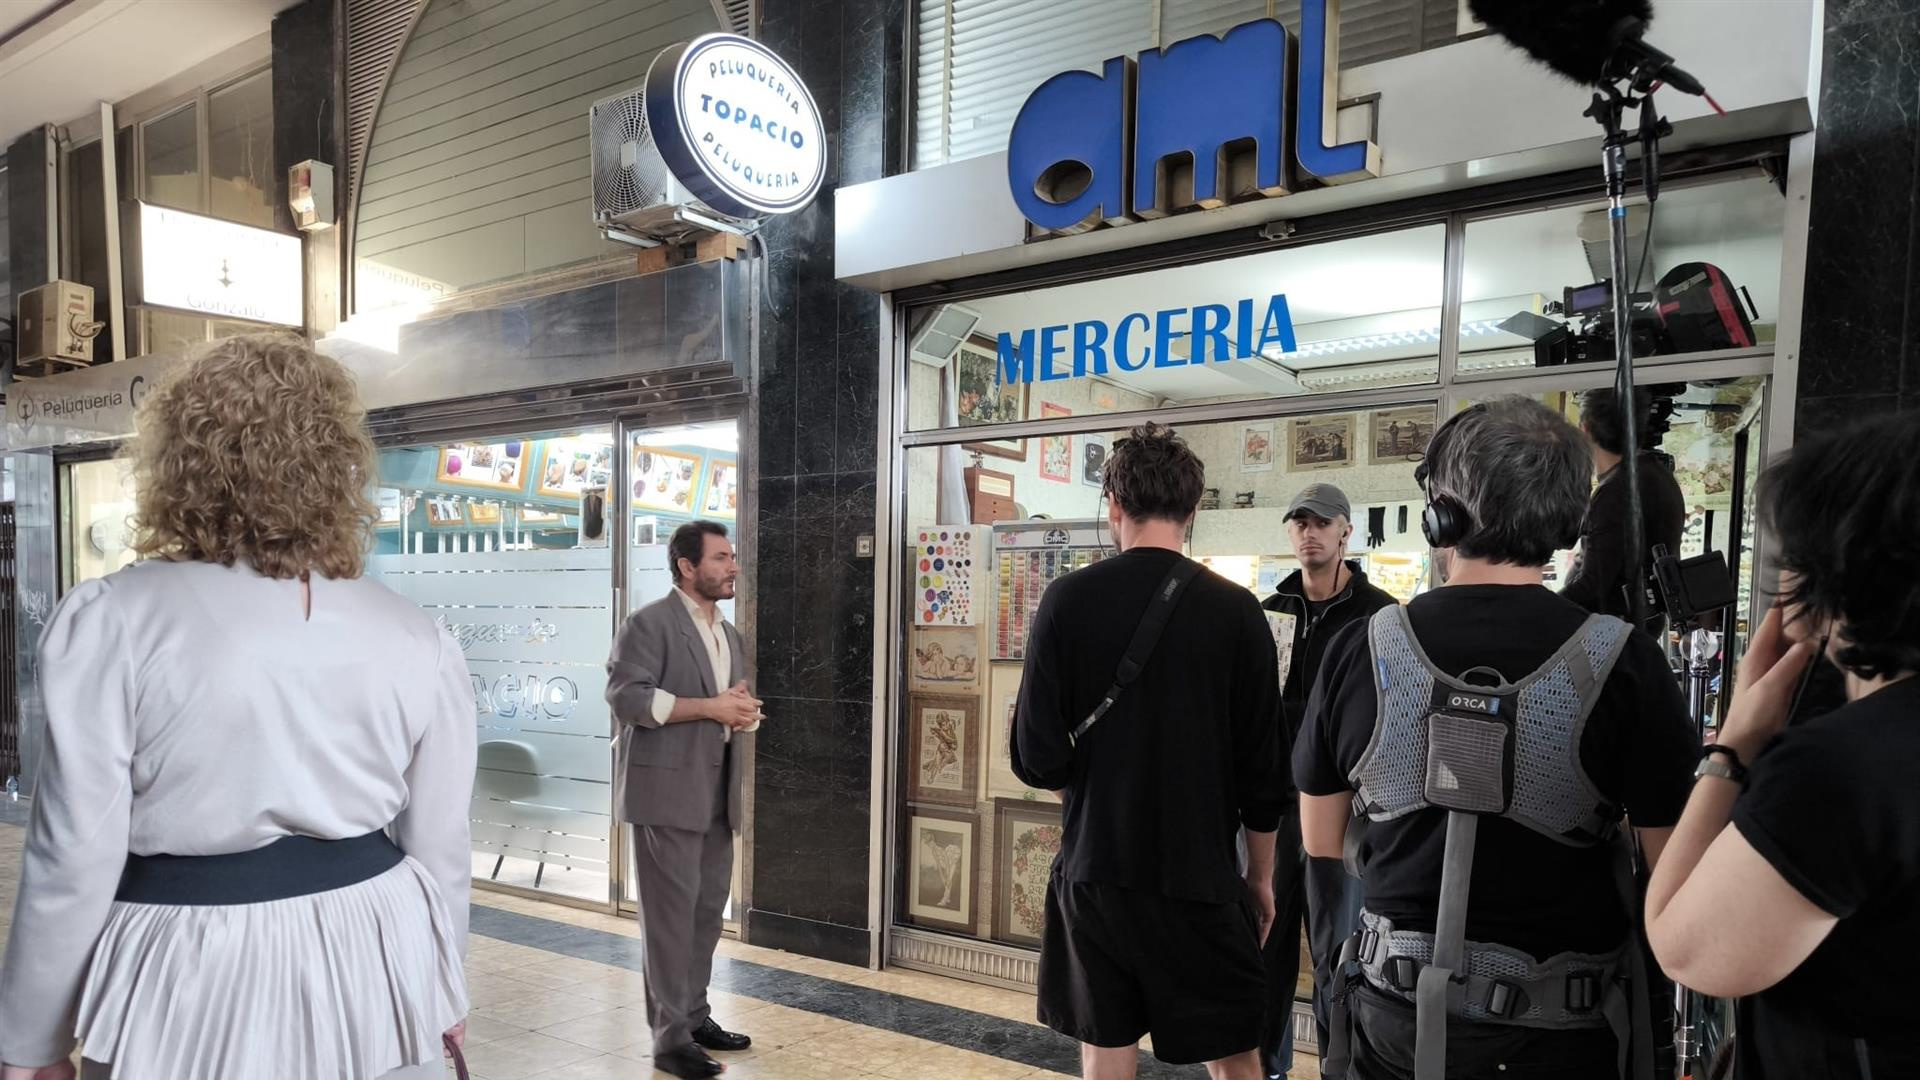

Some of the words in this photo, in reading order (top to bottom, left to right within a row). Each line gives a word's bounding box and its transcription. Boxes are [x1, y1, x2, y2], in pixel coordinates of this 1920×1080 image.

[709, 59, 799, 115] PELUQUERIA
[1007, 0, 1369, 230] aml
[700, 93, 804, 149] TOPACIO
[703, 131, 799, 188] PELUQUERIA
[995, 293, 1298, 386] MERCERIA
[1451, 696, 1486, 710] ORCA
